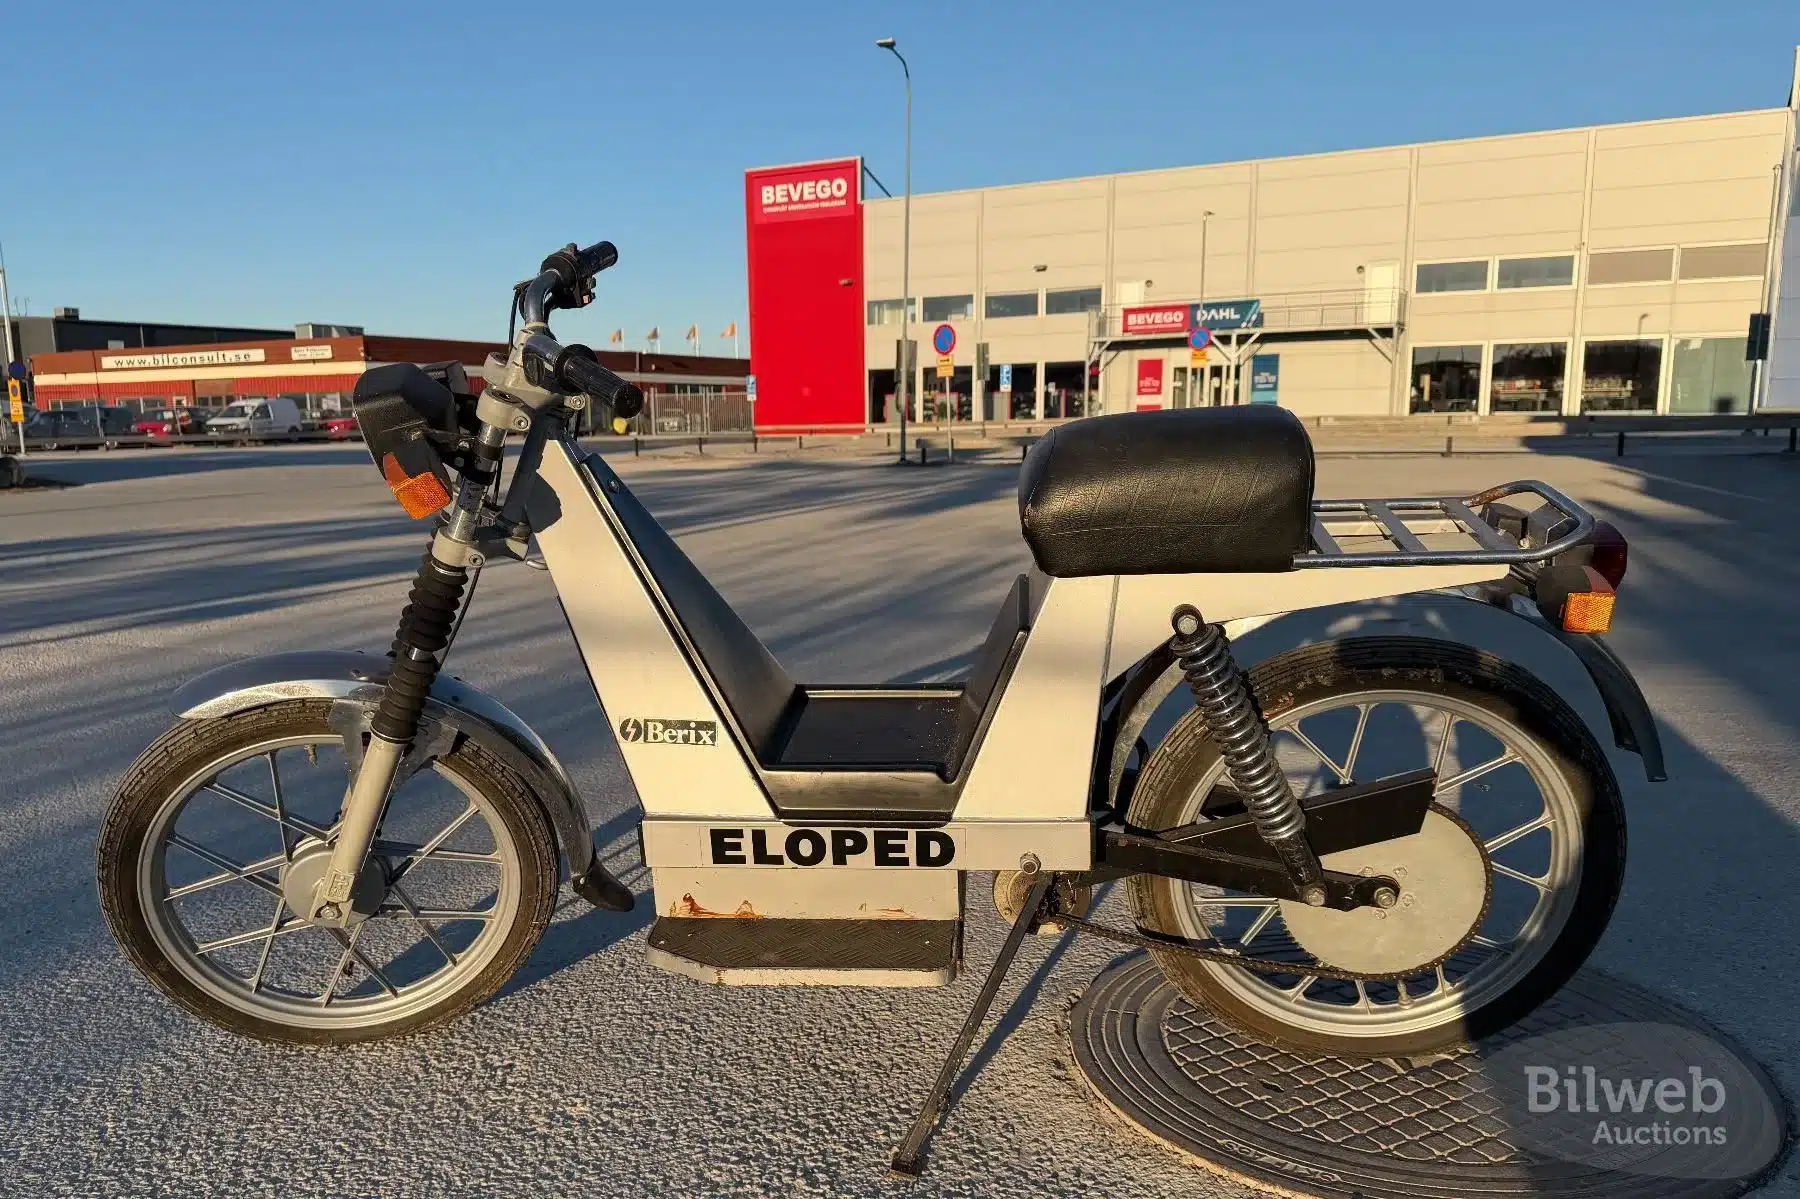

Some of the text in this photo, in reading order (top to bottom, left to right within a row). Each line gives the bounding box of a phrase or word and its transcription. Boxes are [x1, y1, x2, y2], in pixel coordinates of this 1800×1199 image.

[761, 178, 847, 205] BEVEGO
[1127, 311, 1184, 326] BEVEGO
[1196, 307, 1240, 321] DAHL
[114, 351, 251, 368] www.bilconsult.se
[646, 721, 714, 745] Berix
[709, 828, 956, 867] ELOPED
